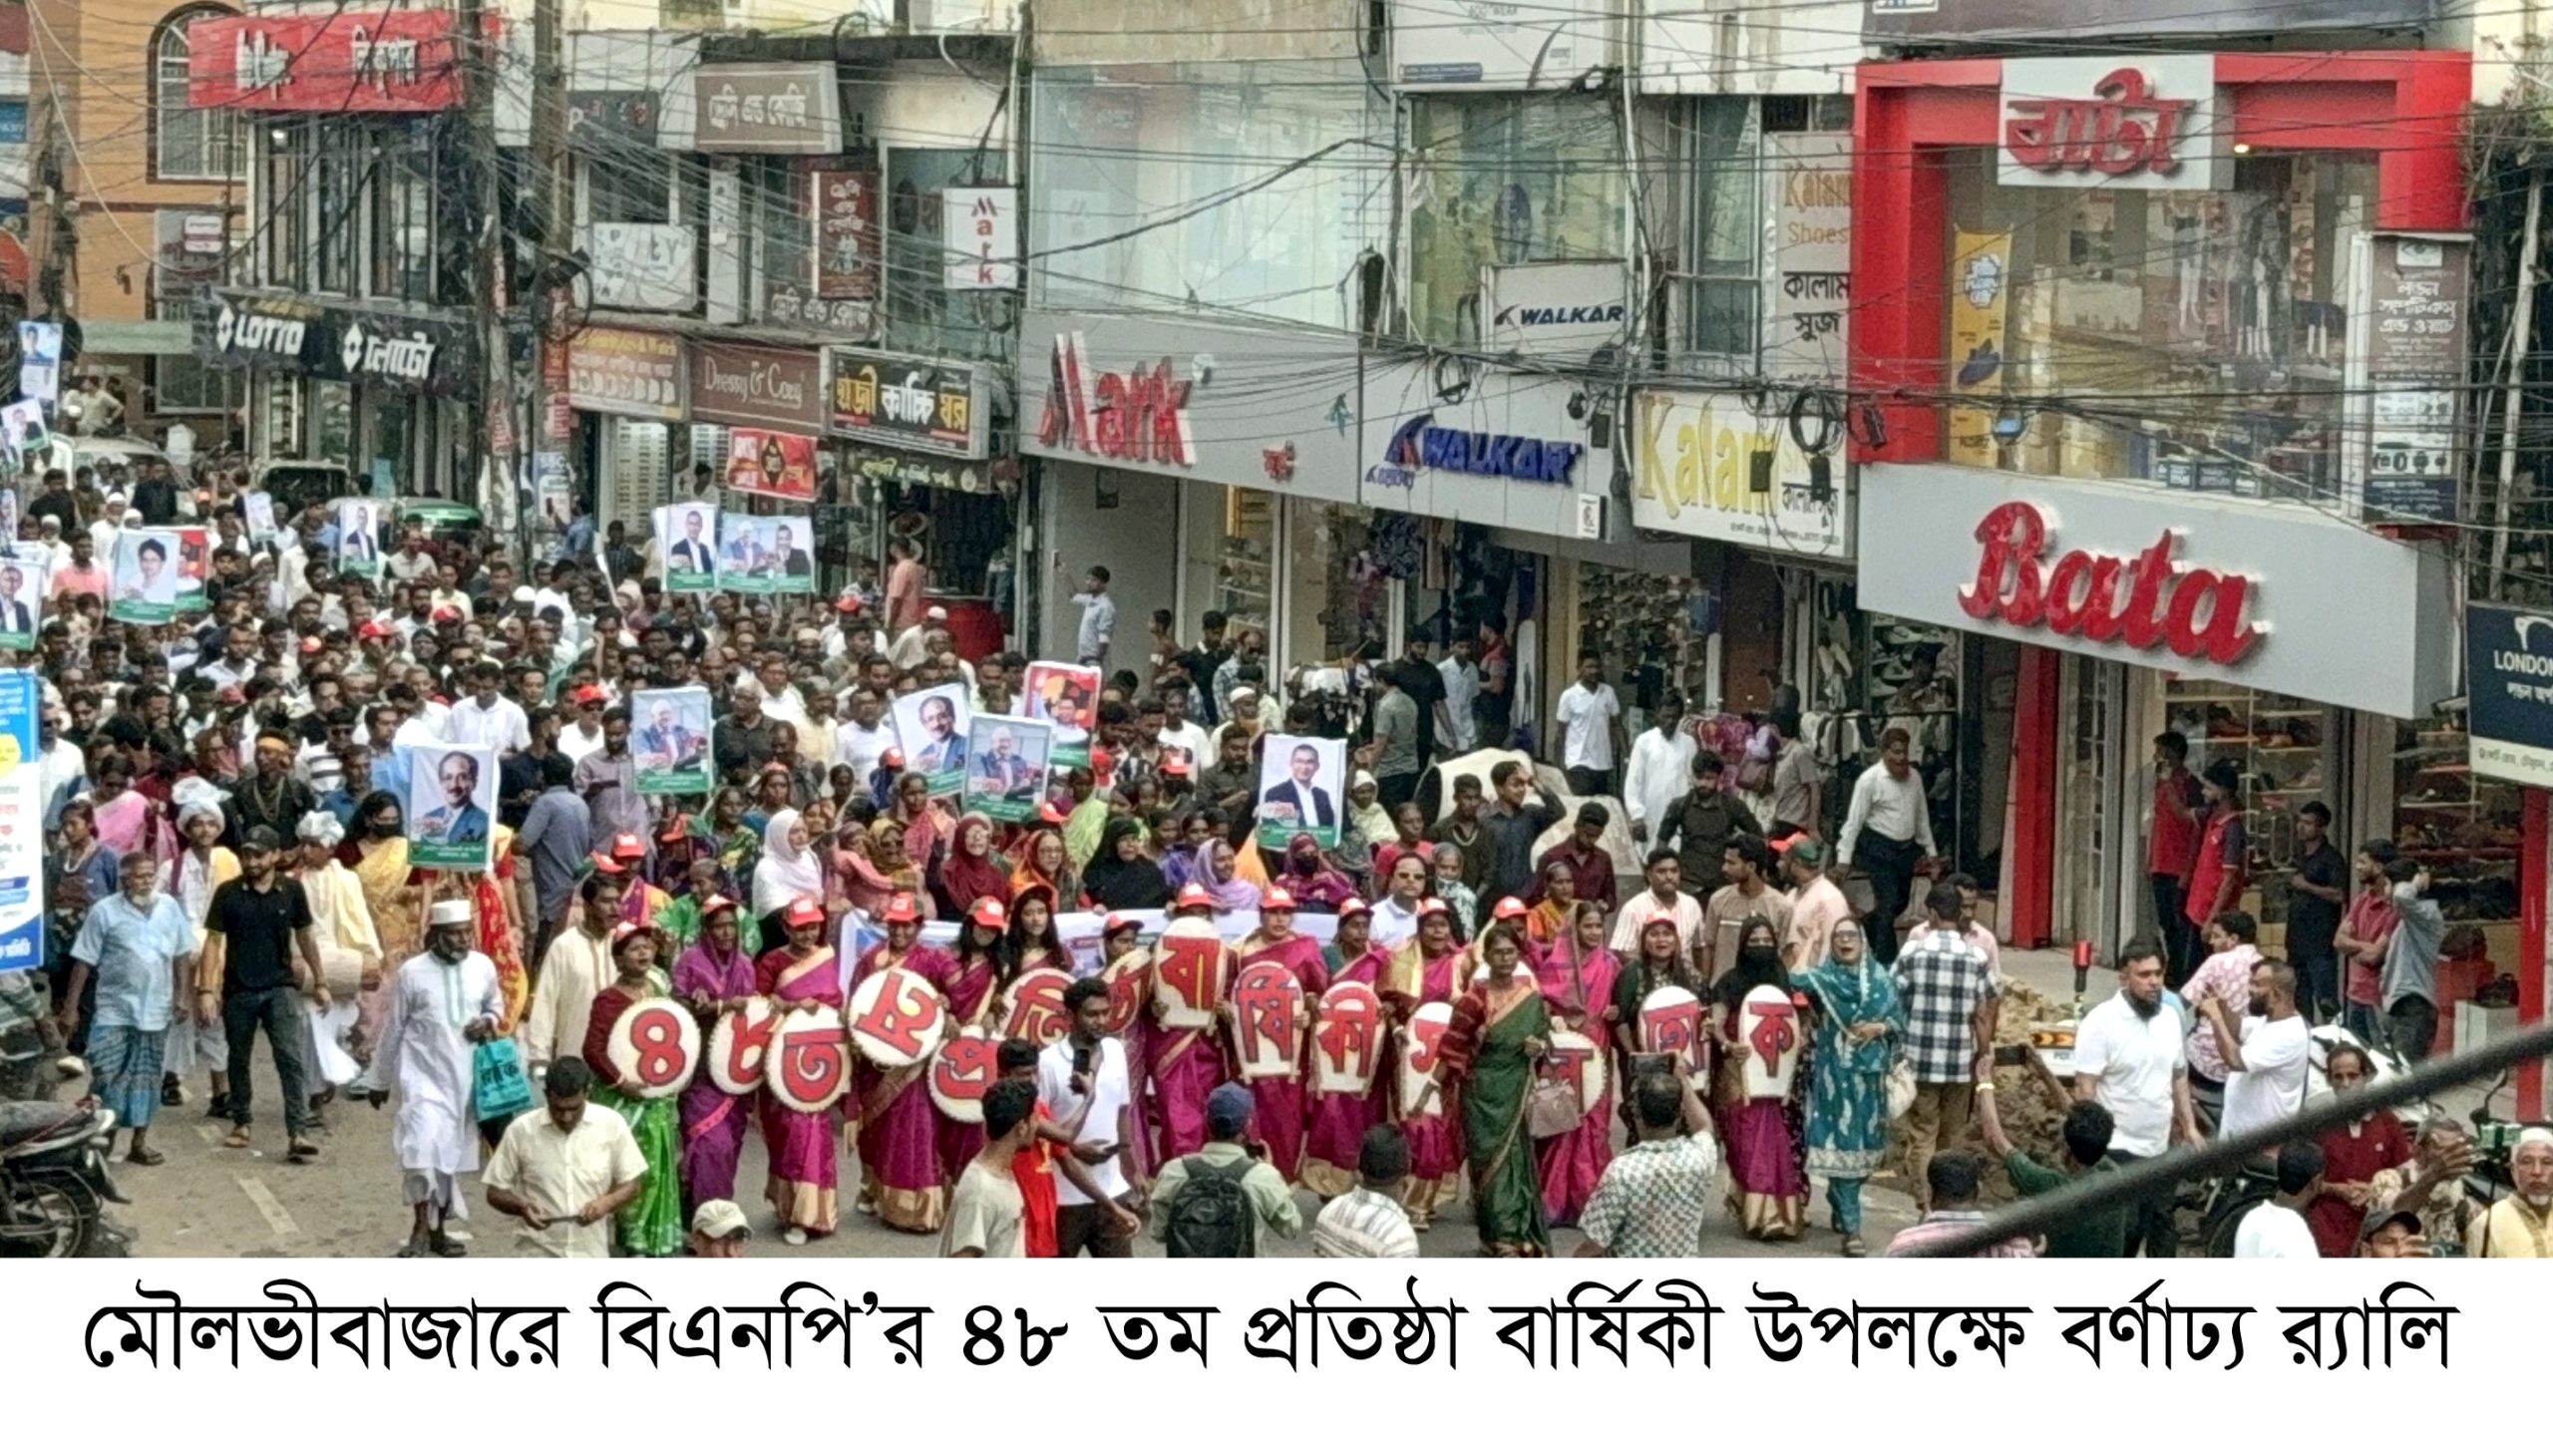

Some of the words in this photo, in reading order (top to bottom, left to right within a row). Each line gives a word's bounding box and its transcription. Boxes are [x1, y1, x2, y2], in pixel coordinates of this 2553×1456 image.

[2006, 68, 2192, 175] বাটা
[971, 195, 997, 284] Mark
[1787, 221, 1849, 244] Shoes
[235, 314, 305, 355] LOTTO
[1521, 305, 1625, 325] WALKAR
[1793, 311, 1841, 342] সুজ
[365, 331, 436, 379] লোটো
[705, 356, 748, 402] Dressy
[1039, 333, 1193, 466] Mark
[1423, 426, 1576, 487] WALKAR
[1958, 501, 2260, 664] Bata
[631, 1008, 686, 1085] ৪
[729, 1010, 783, 1084] ৮
[1749, 1000, 1795, 1078] ক
